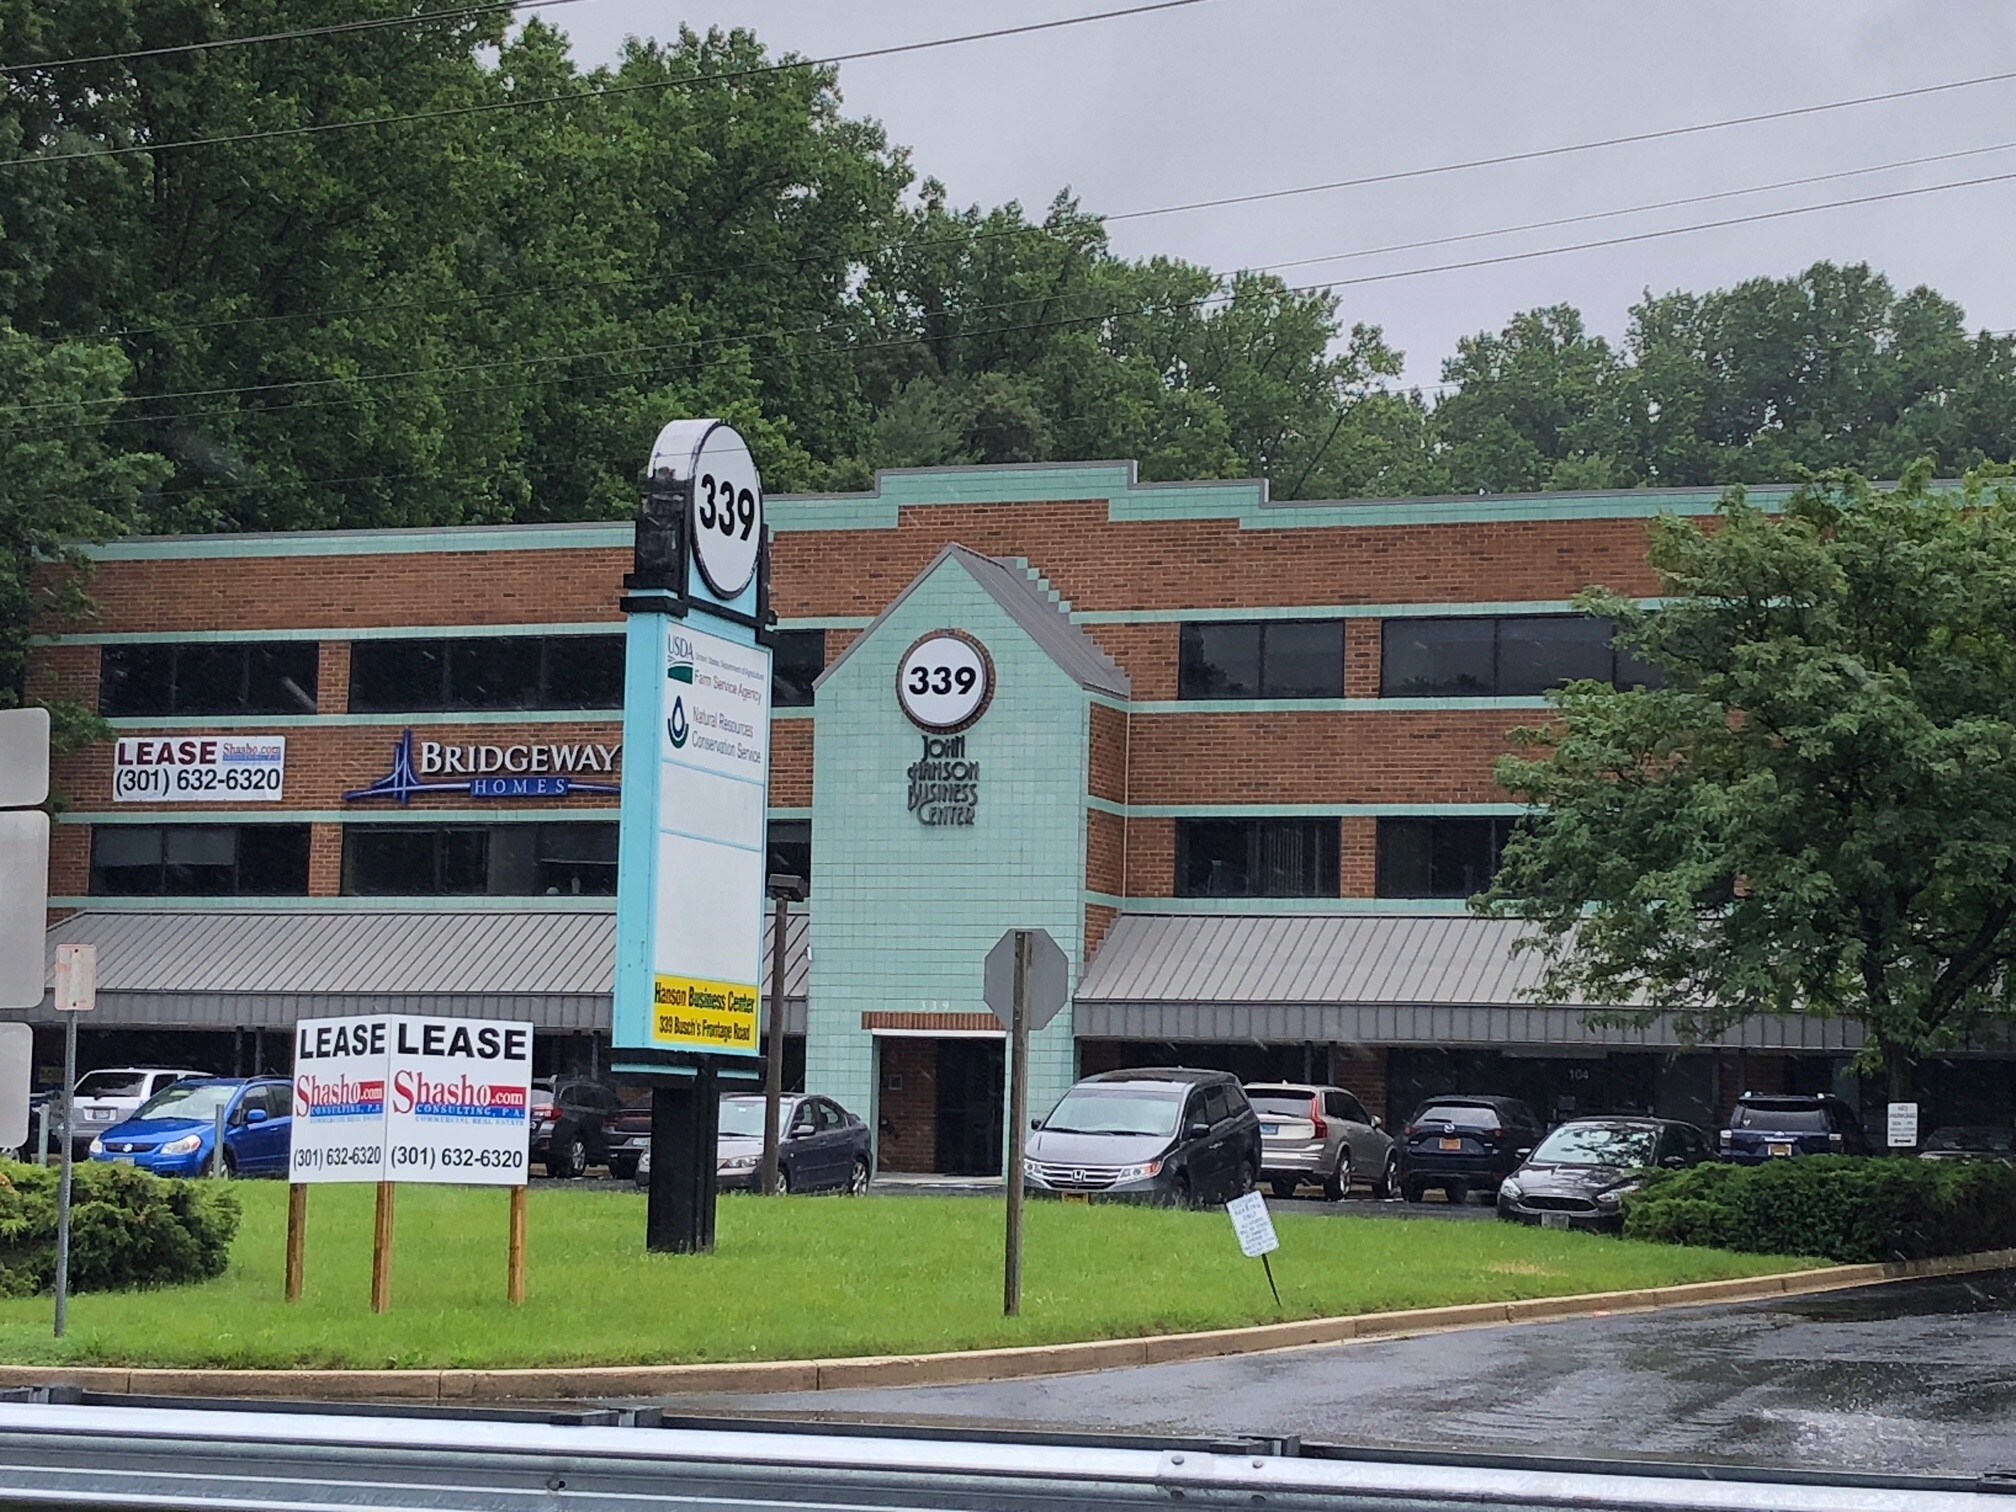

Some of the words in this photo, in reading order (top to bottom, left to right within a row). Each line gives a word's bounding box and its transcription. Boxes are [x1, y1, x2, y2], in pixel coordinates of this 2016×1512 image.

[699, 473, 755, 542] 339
[668, 634, 694, 660] USDA
[694, 669, 712, 686] Farm
[713, 675, 738, 695] Service
[738, 683, 762, 705] Agency
[908, 666, 977, 695] 339
[693, 706, 718, 727] Natural
[719, 713, 754, 738] Resources
[117, 741, 217, 766] LEASE
[420, 741, 622, 774] BRIDGEWAY
[692, 730, 736, 757] Conservation
[737, 743, 761, 764] Service
[116, 768, 170, 797] (301)
[177, 768, 280, 791] 632-6320
[474, 778, 566, 794] HOMES
[654, 981, 687, 1007] Hanson
[688, 986, 726, 1011] Business
[727, 990, 755, 1013] Center
[300, 1022, 386, 1059] LEASE
[398, 1023, 527, 1060] LEASE
[659, 1015, 673, 1033] 339
[701, 1019, 733, 1043] Frontage
[733, 1022, 751, 1041] Road
[293, 1148, 324, 1171] (301)
[327, 1146, 382, 1166] 632-6320
[391, 1147, 436, 1170] (301)
[441, 1148, 523, 1168] 632-6320
